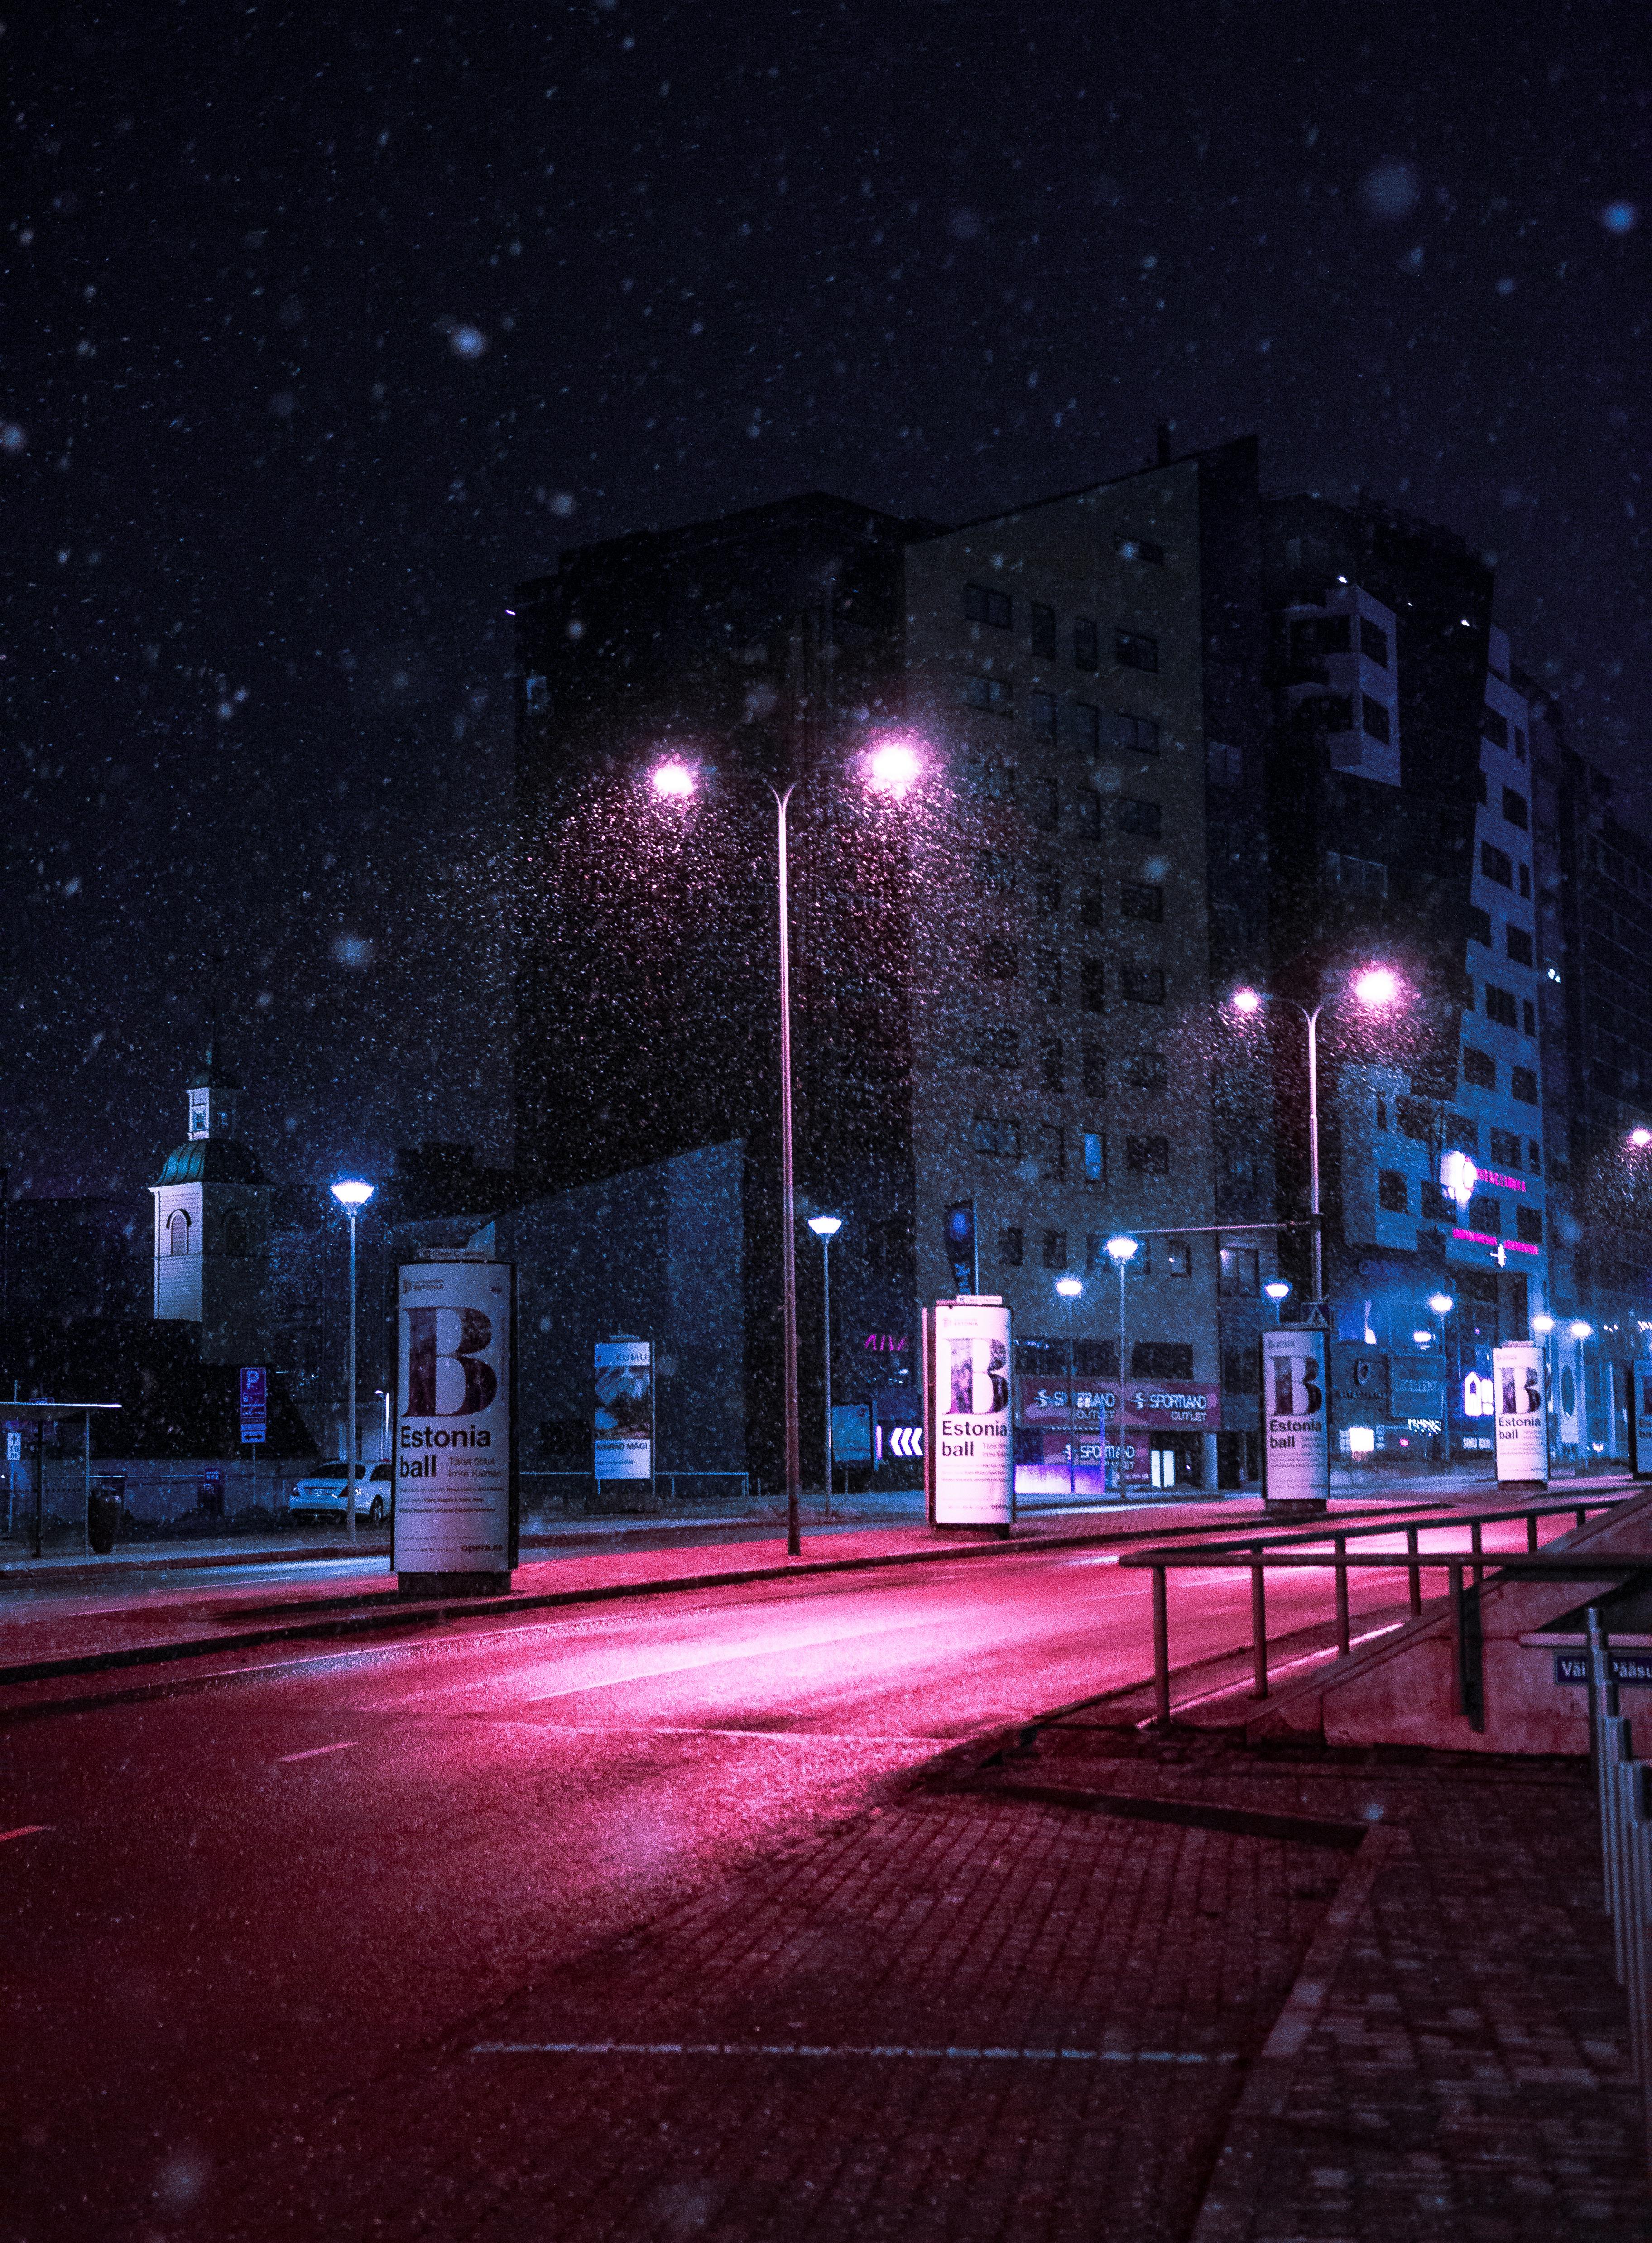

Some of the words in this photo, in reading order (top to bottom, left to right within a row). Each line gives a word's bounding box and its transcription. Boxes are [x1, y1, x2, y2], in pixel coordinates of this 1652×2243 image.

[247, 1370, 260, 1389] P
[1149, 1393, 1207, 1409] SPORTLAND
[1170, 1411, 1207, 1422] OUTLET
[1498, 1417, 1541, 1426] Estonia
[942, 1420, 1007, 1436] Estonia
[1270, 1419, 1321, 1432] Estonia
[401, 1425, 490, 1447] Estonia
[1270, 1435, 1295, 1448] ball
[1499, 1429, 1518, 1439] ball
[942, 1441, 974, 1456] ball
[400, 1455, 436, 1477] ball
